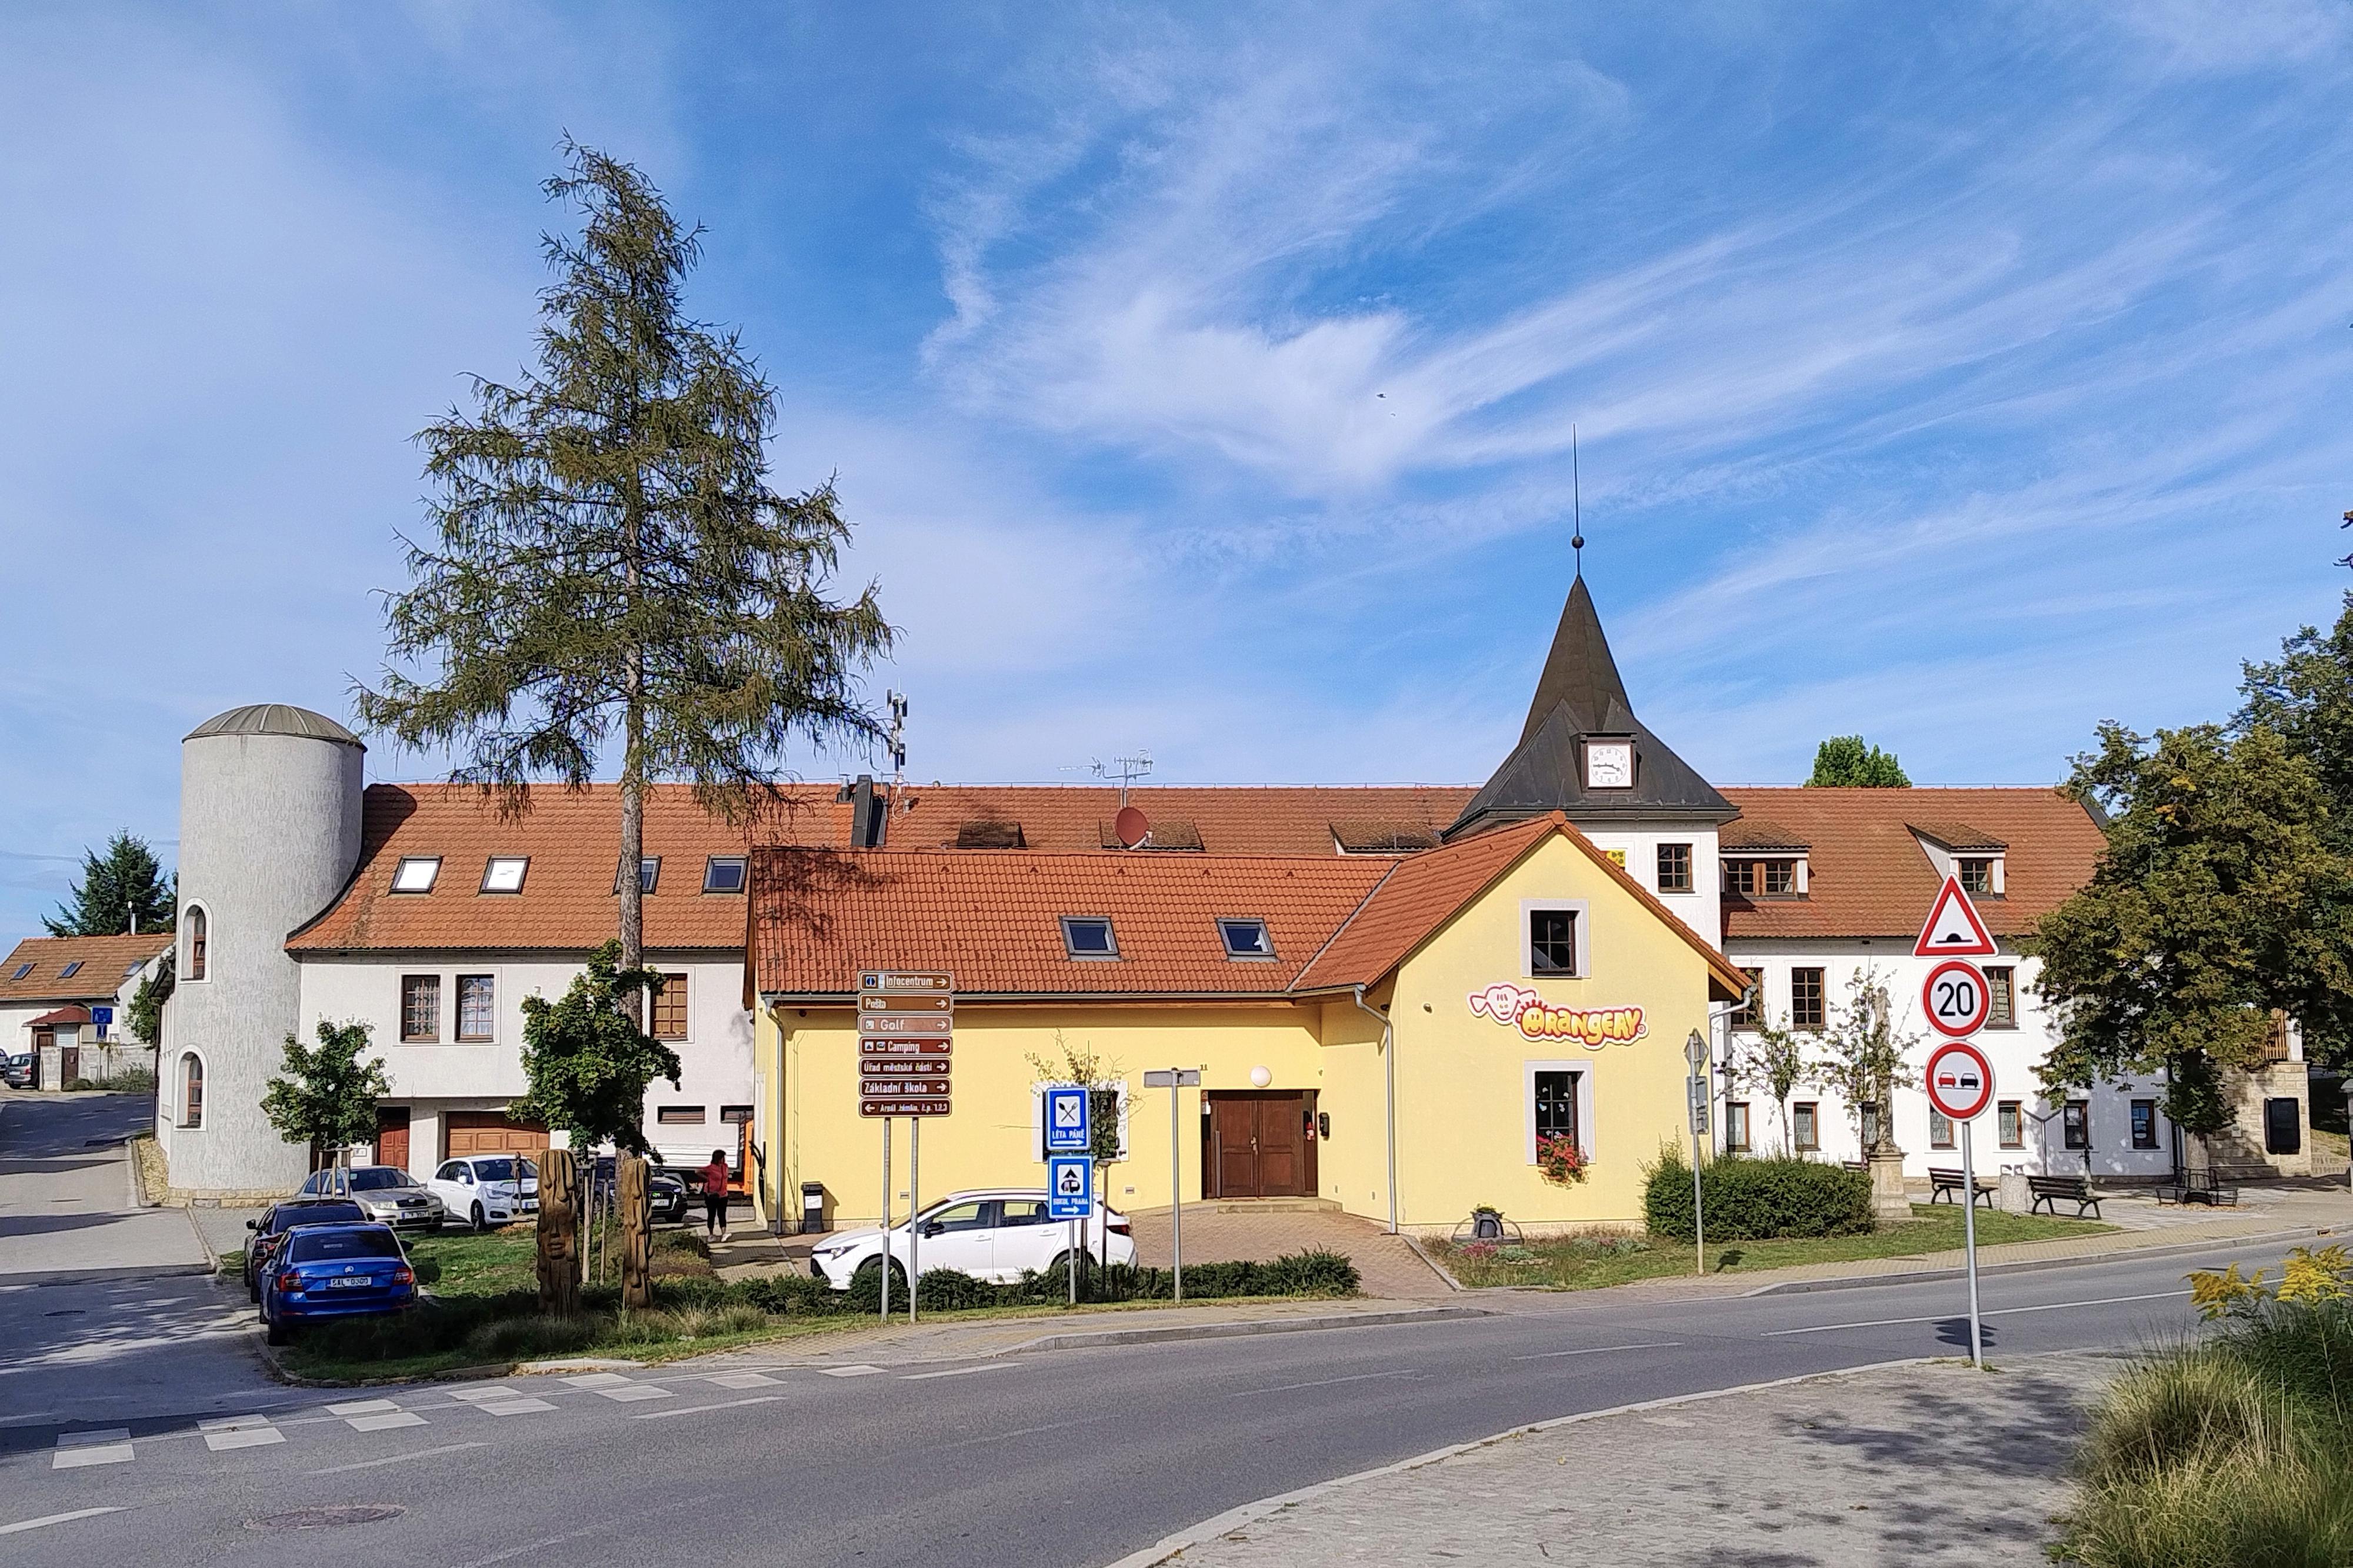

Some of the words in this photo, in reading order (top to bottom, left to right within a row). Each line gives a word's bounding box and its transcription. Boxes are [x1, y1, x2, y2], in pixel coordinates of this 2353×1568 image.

[886, 976, 934, 986] Infocentrum
[1938, 982, 1974, 1017] 20
[880, 1019, 905, 1030] Golf
[888, 1040, 920, 1054] Camping
[864, 1082, 902, 1093] Základní
[904, 1082, 927, 1093] škola
